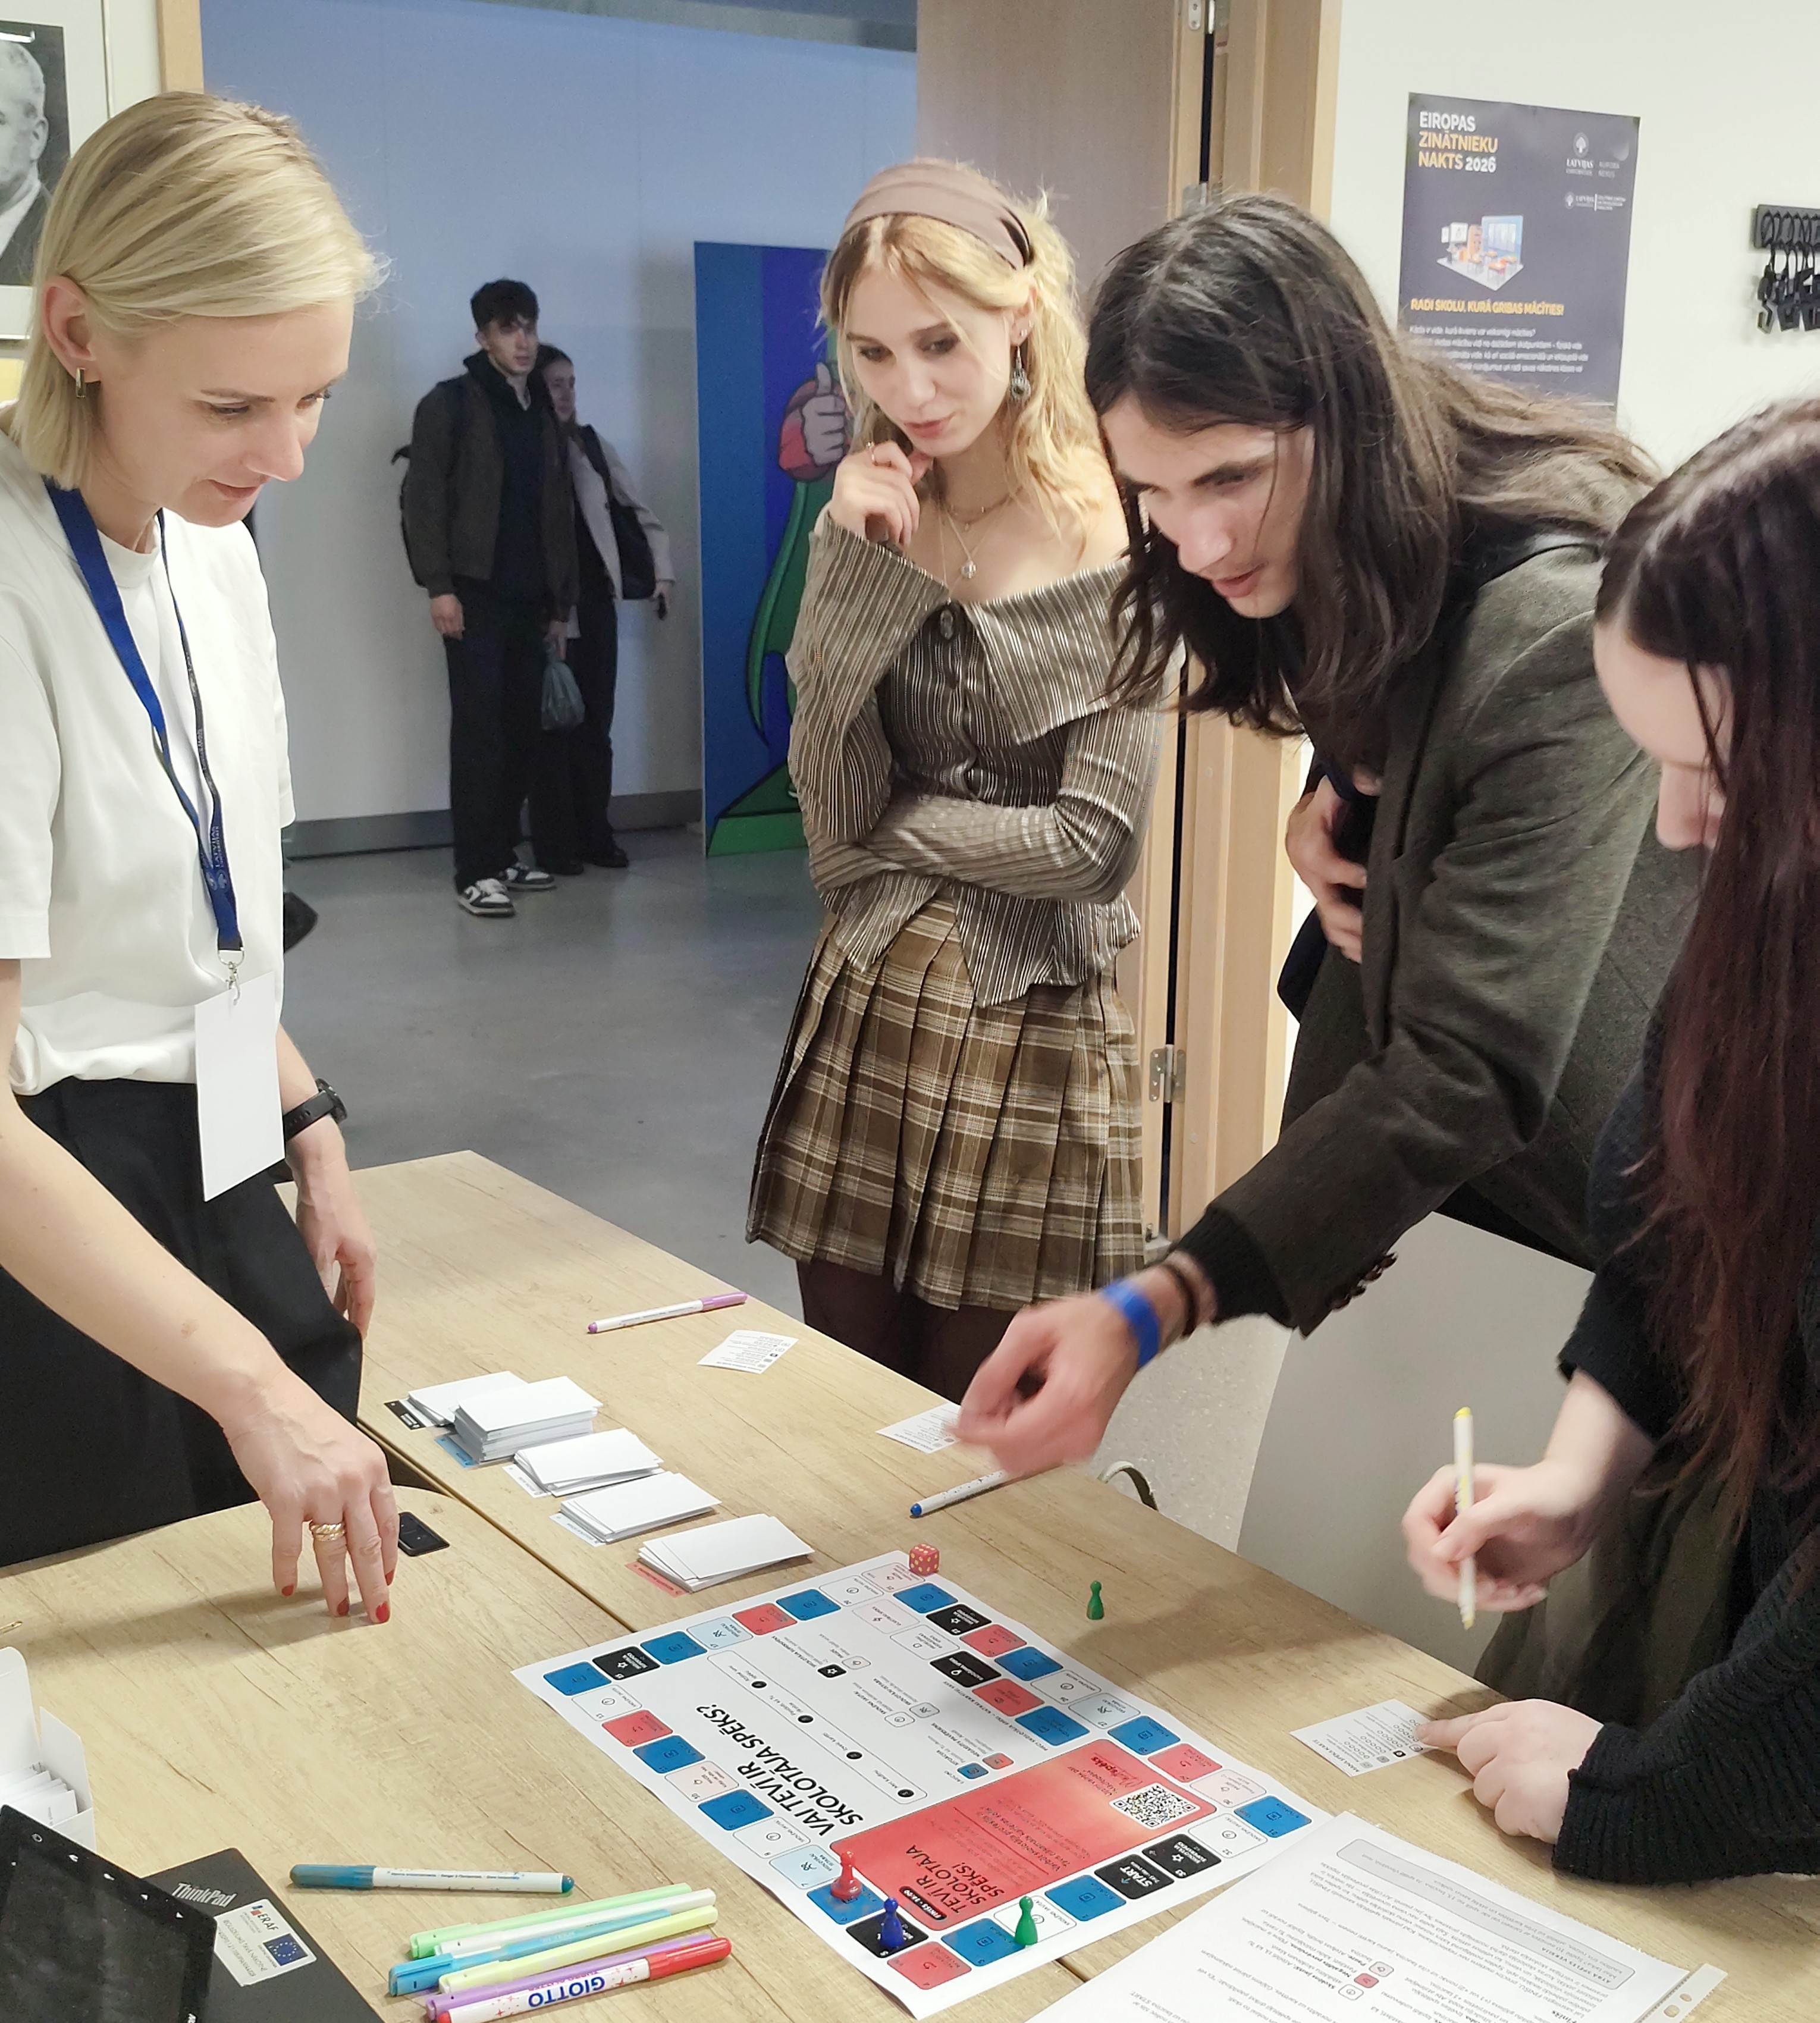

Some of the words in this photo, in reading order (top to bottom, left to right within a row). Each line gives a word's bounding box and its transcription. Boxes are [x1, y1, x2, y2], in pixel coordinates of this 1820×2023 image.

[1420, 111, 1476, 132] EIROPAS
[1419, 130, 1498, 153] ZINĀTNIEKU
[1419, 151, 1463, 170] NAKTS
[1465, 156, 1497, 173] 2026
[1411, 299, 1433, 310] RADI
[1435, 300, 1466, 313] SKOLU,
[1492, 301, 1523, 314] GRIBAS
[696, 1704, 764, 1748] SPĒKS?
[737, 1761, 766, 1779] IR
[750, 1777, 804, 1811] TEVĪ
[755, 1746, 863, 1824] SKOLOTĀJA
[794, 1808, 834, 1836] VAI
[899, 1844, 988, 1907] SKOLOTĀJA
[910, 1874, 939, 1891] IR
[948, 1861, 1006, 1899] SPĒKS!
[1119, 1866, 1152, 1886] START
[1173, 1868, 1188, 1877] 33
[172, 1882, 236, 1908] ThinkPad
[924, 1884, 969, 1915] TEVĪ
[256, 1912, 280, 1933] ERAF
[528, 1976, 605, 2009] GIOTTO
